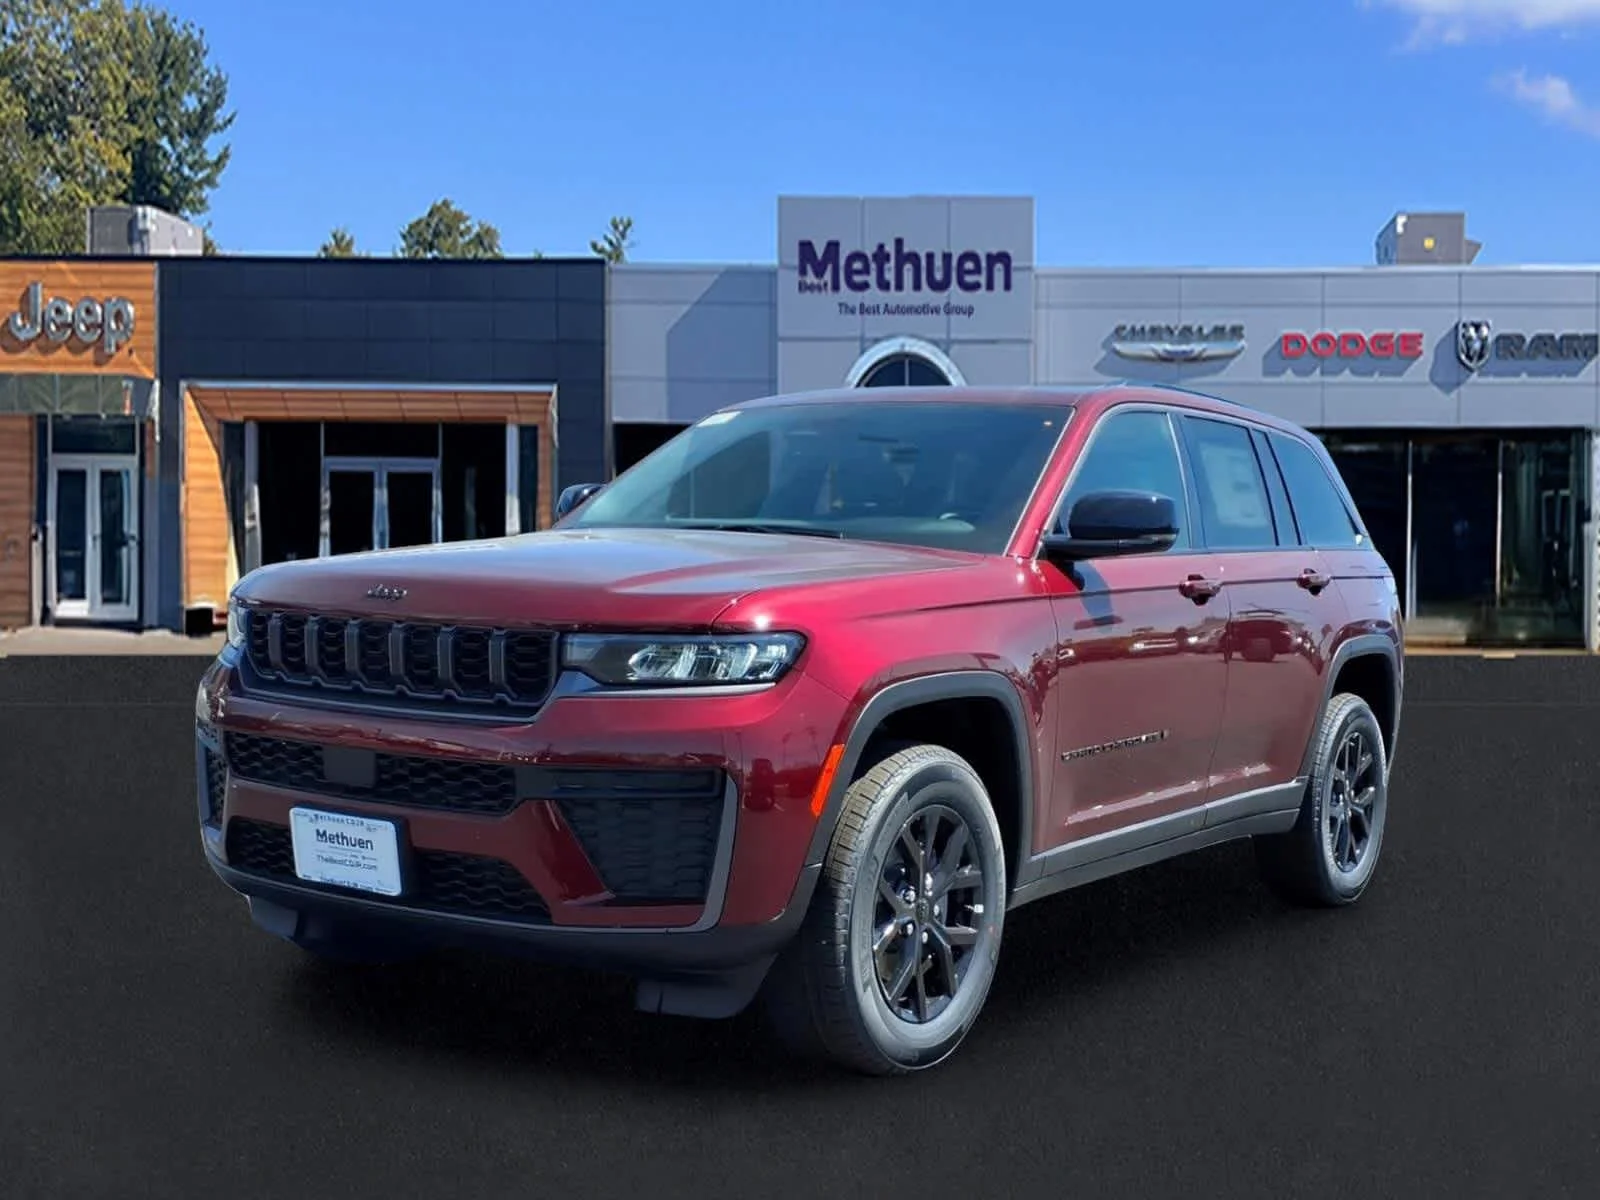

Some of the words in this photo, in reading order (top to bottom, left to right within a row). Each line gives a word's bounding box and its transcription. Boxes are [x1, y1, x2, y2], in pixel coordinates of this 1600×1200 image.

[798, 238, 1012, 292] Methuen
[9, 281, 135, 354] Jeep
[838, 302, 857, 315] The
[859, 302, 880, 315] Best
[883, 303, 941, 315] Automotive
[943, 302, 974, 318] Group
[1114, 324, 1245, 341] CHRYSLER
[1282, 331, 1424, 357] DODGE
[1495, 333, 1598, 360] RAM
[315, 829, 374, 850] Methuen
